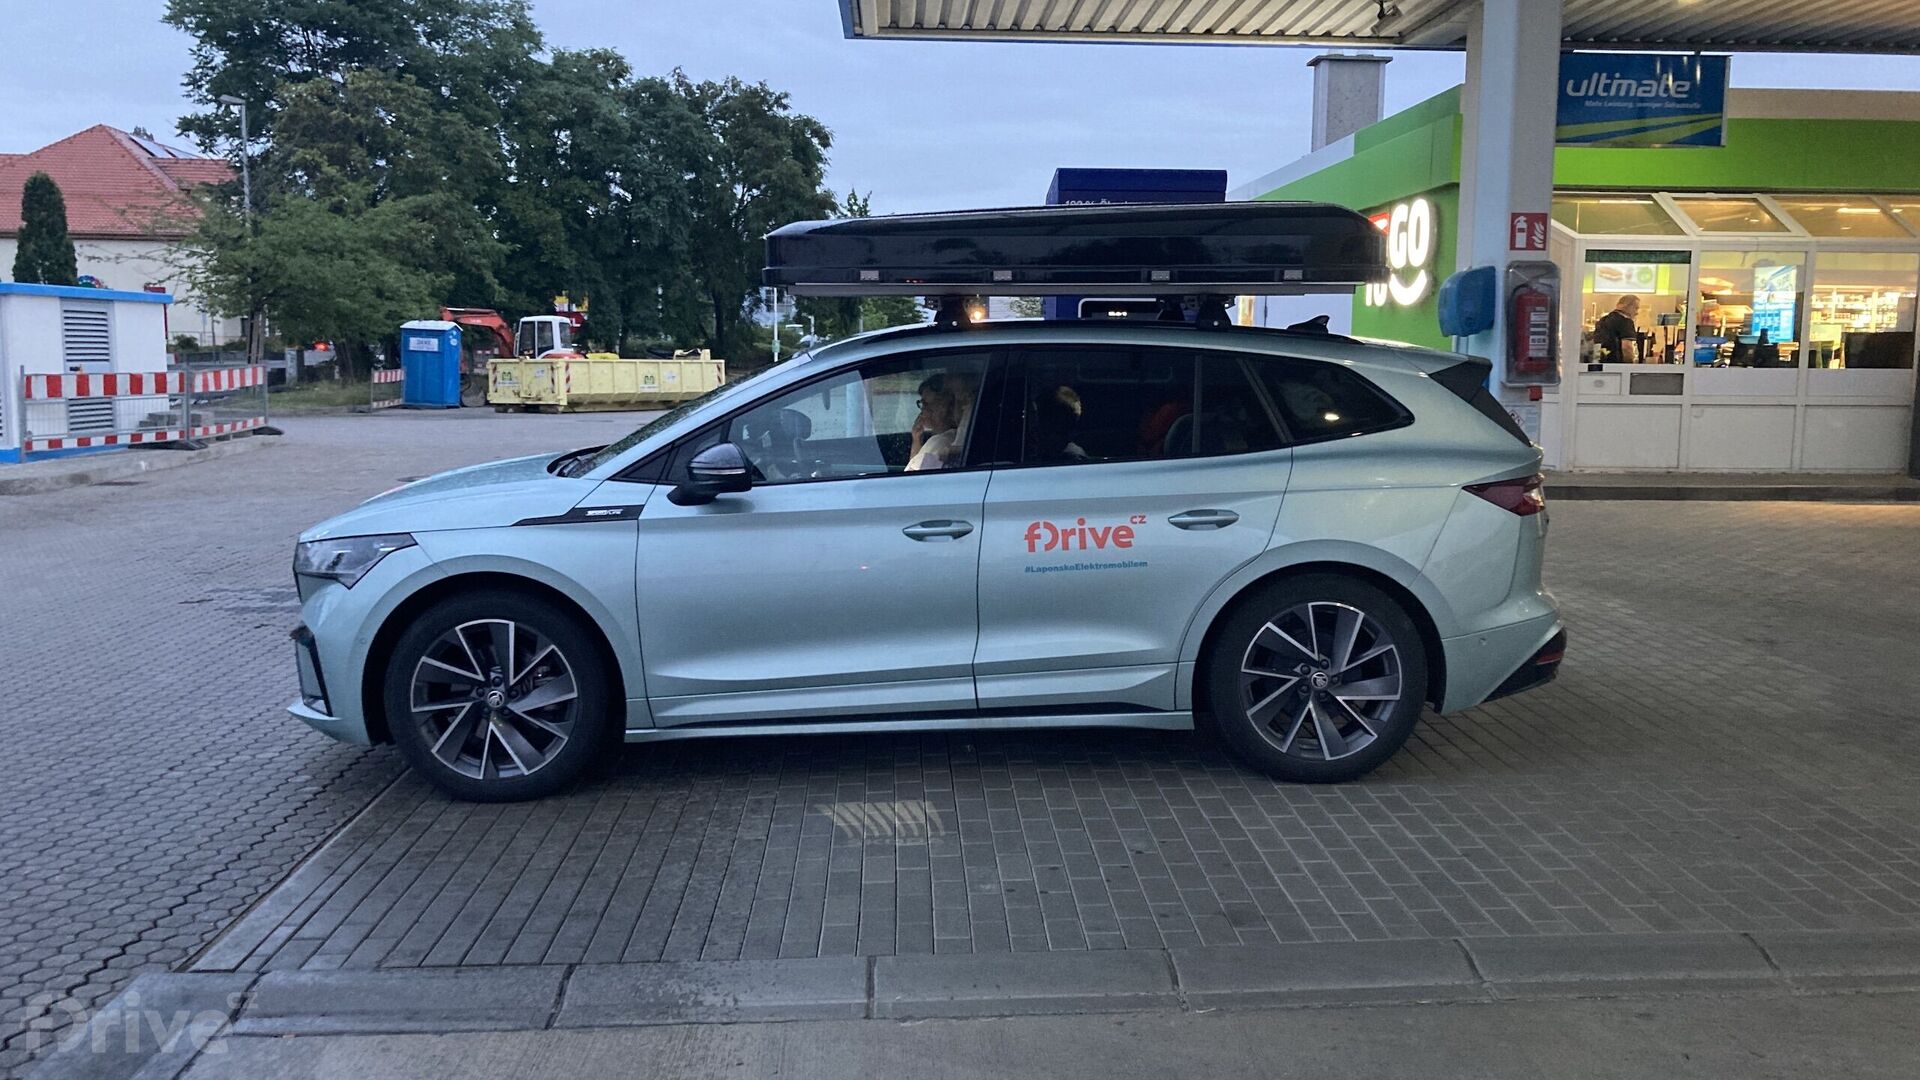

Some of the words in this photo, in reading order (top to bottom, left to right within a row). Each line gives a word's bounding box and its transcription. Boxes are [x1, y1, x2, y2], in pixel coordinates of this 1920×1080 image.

[1566, 72, 1691, 98] ultimate
[1389, 198, 1431, 269] GO
[1024, 560, 1149, 574] #LaponskoElektromobilem
